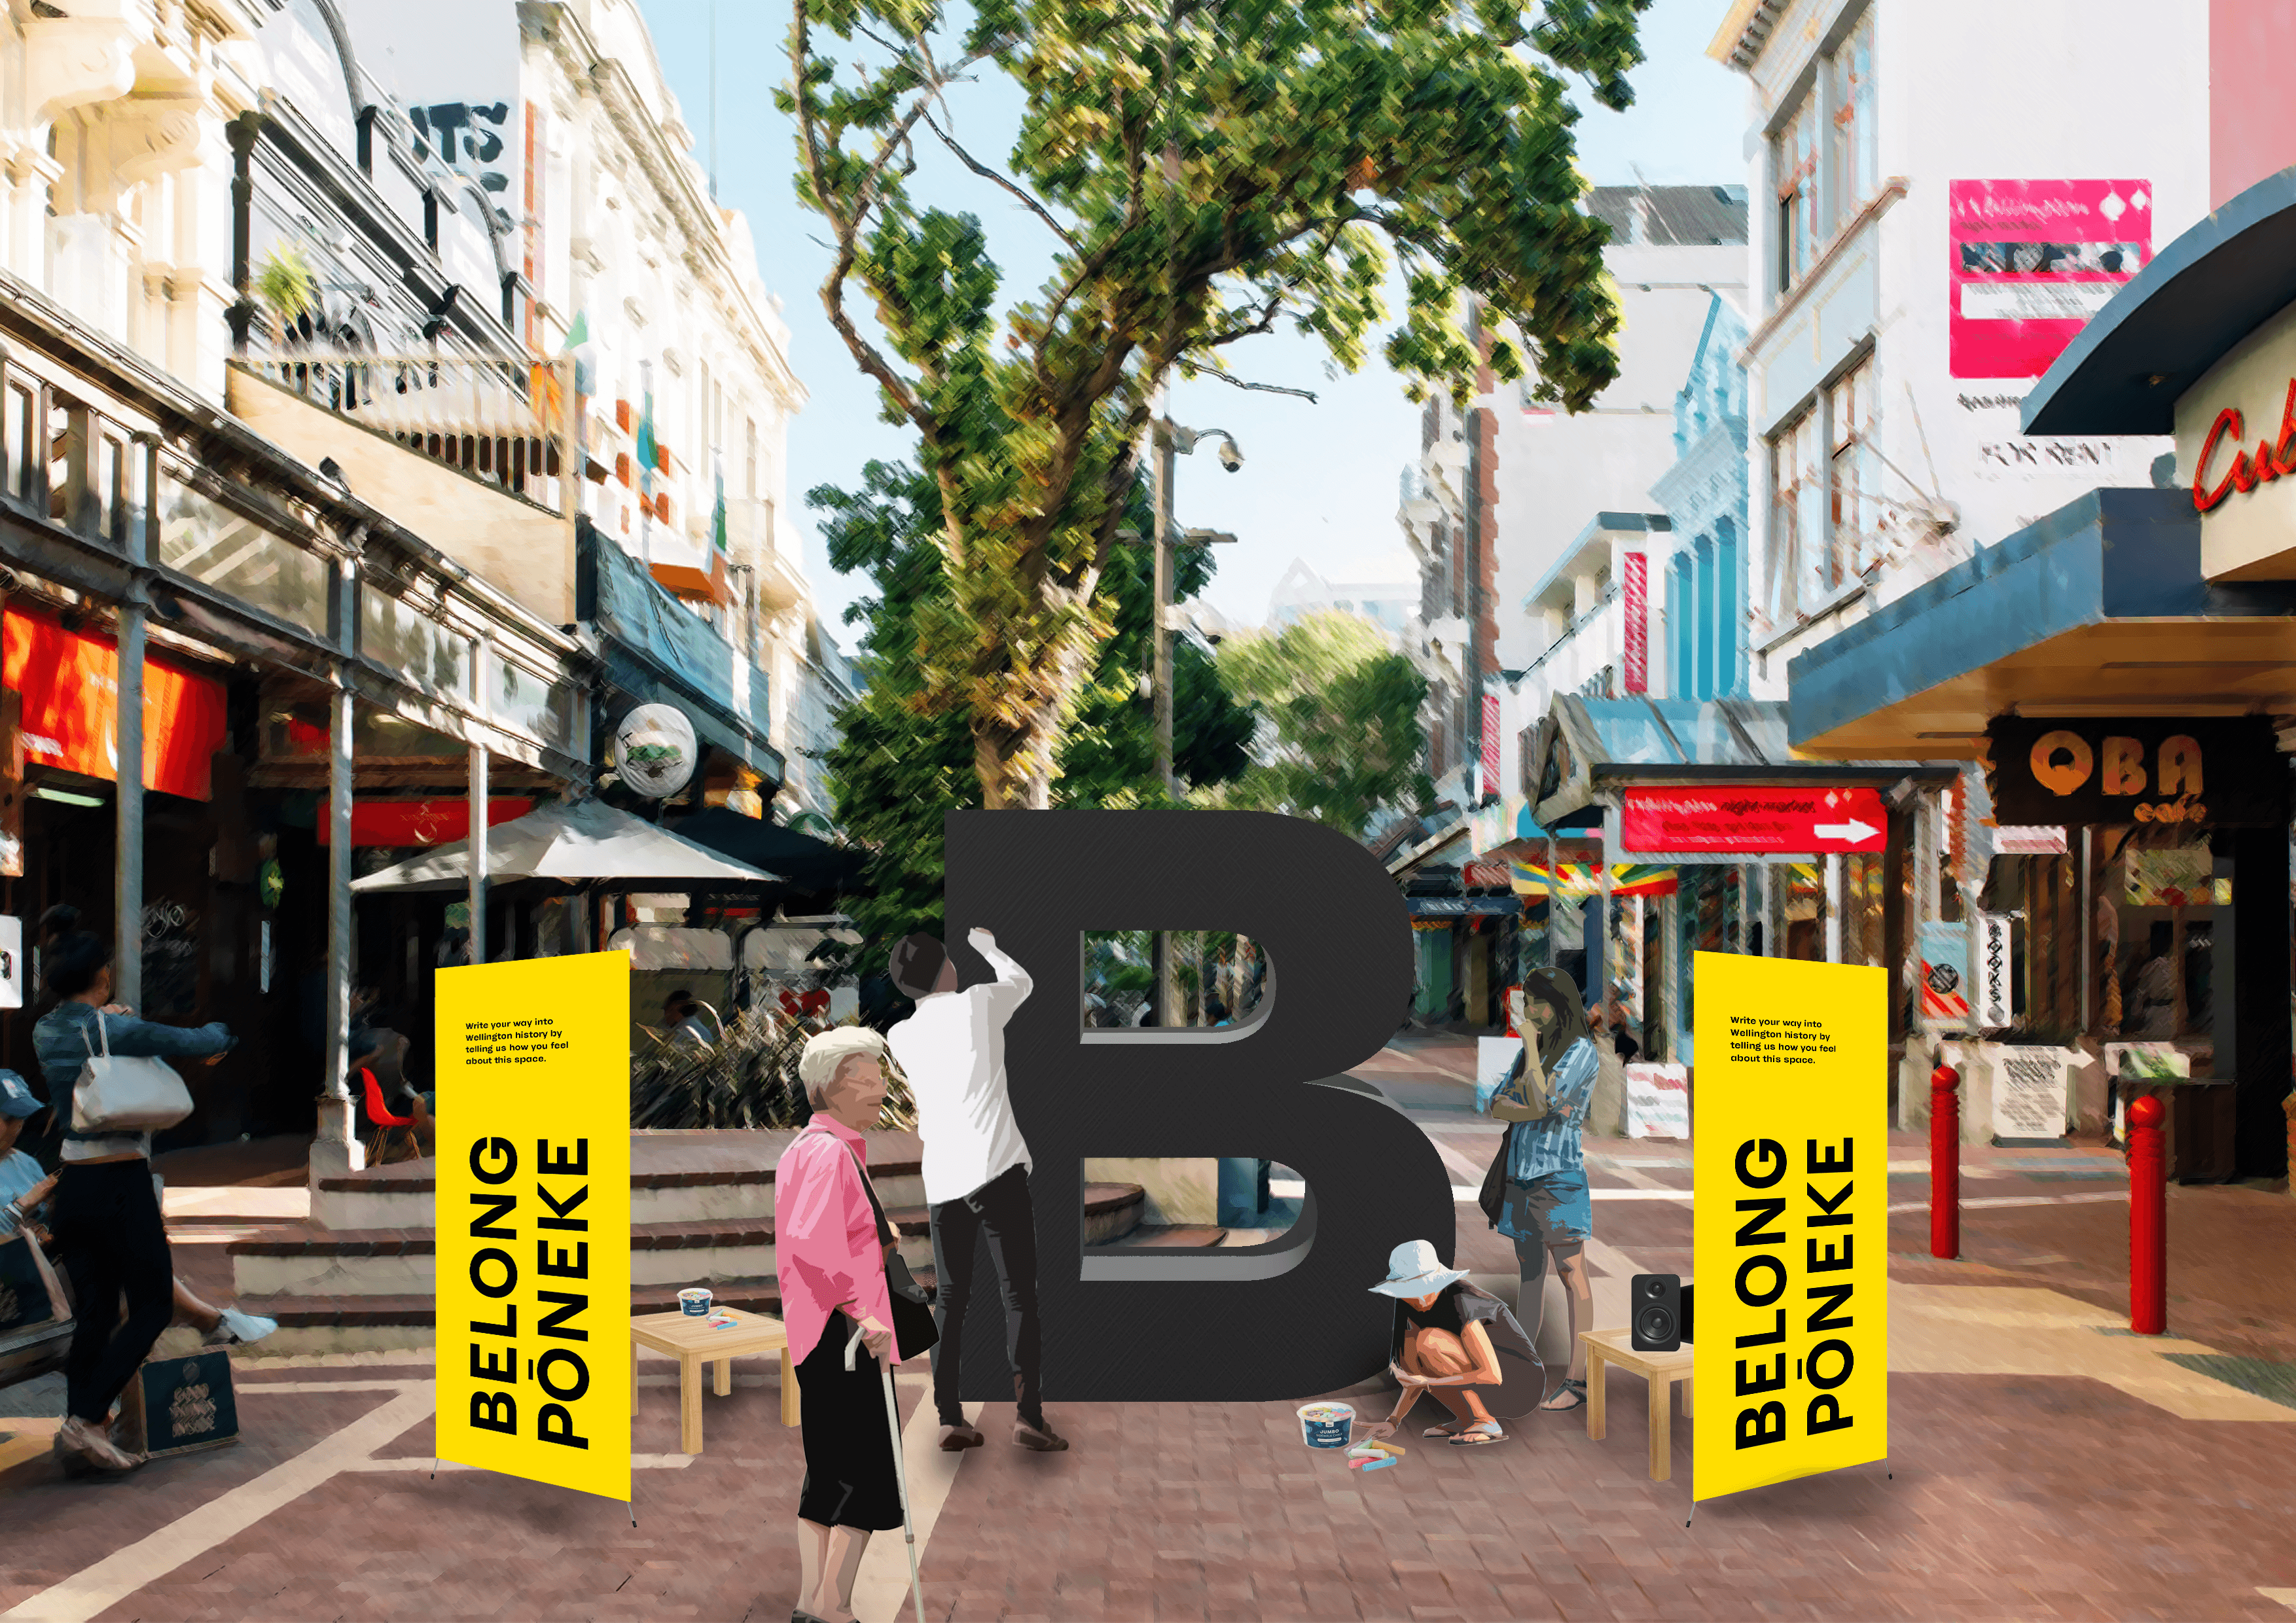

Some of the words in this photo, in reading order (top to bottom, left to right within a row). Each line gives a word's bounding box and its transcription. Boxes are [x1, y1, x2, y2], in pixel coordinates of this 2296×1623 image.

[465, 1033, 512, 1041] Wellington
[465, 1045, 493, 1054] telling
[1731, 1029, 1781, 1039] Wellington
[1785, 1031, 1816, 1041] history
[1820, 1033, 1830, 1041] by
[1731, 1042, 1761, 1051] telling
[470, 1137, 517, 1435] BELONG
[528, 1139, 589, 1450] PŌNEKE
[1735, 1139, 1787, 1450] BELONG
[1797, 1137, 1854, 1436] PŌNEKE
